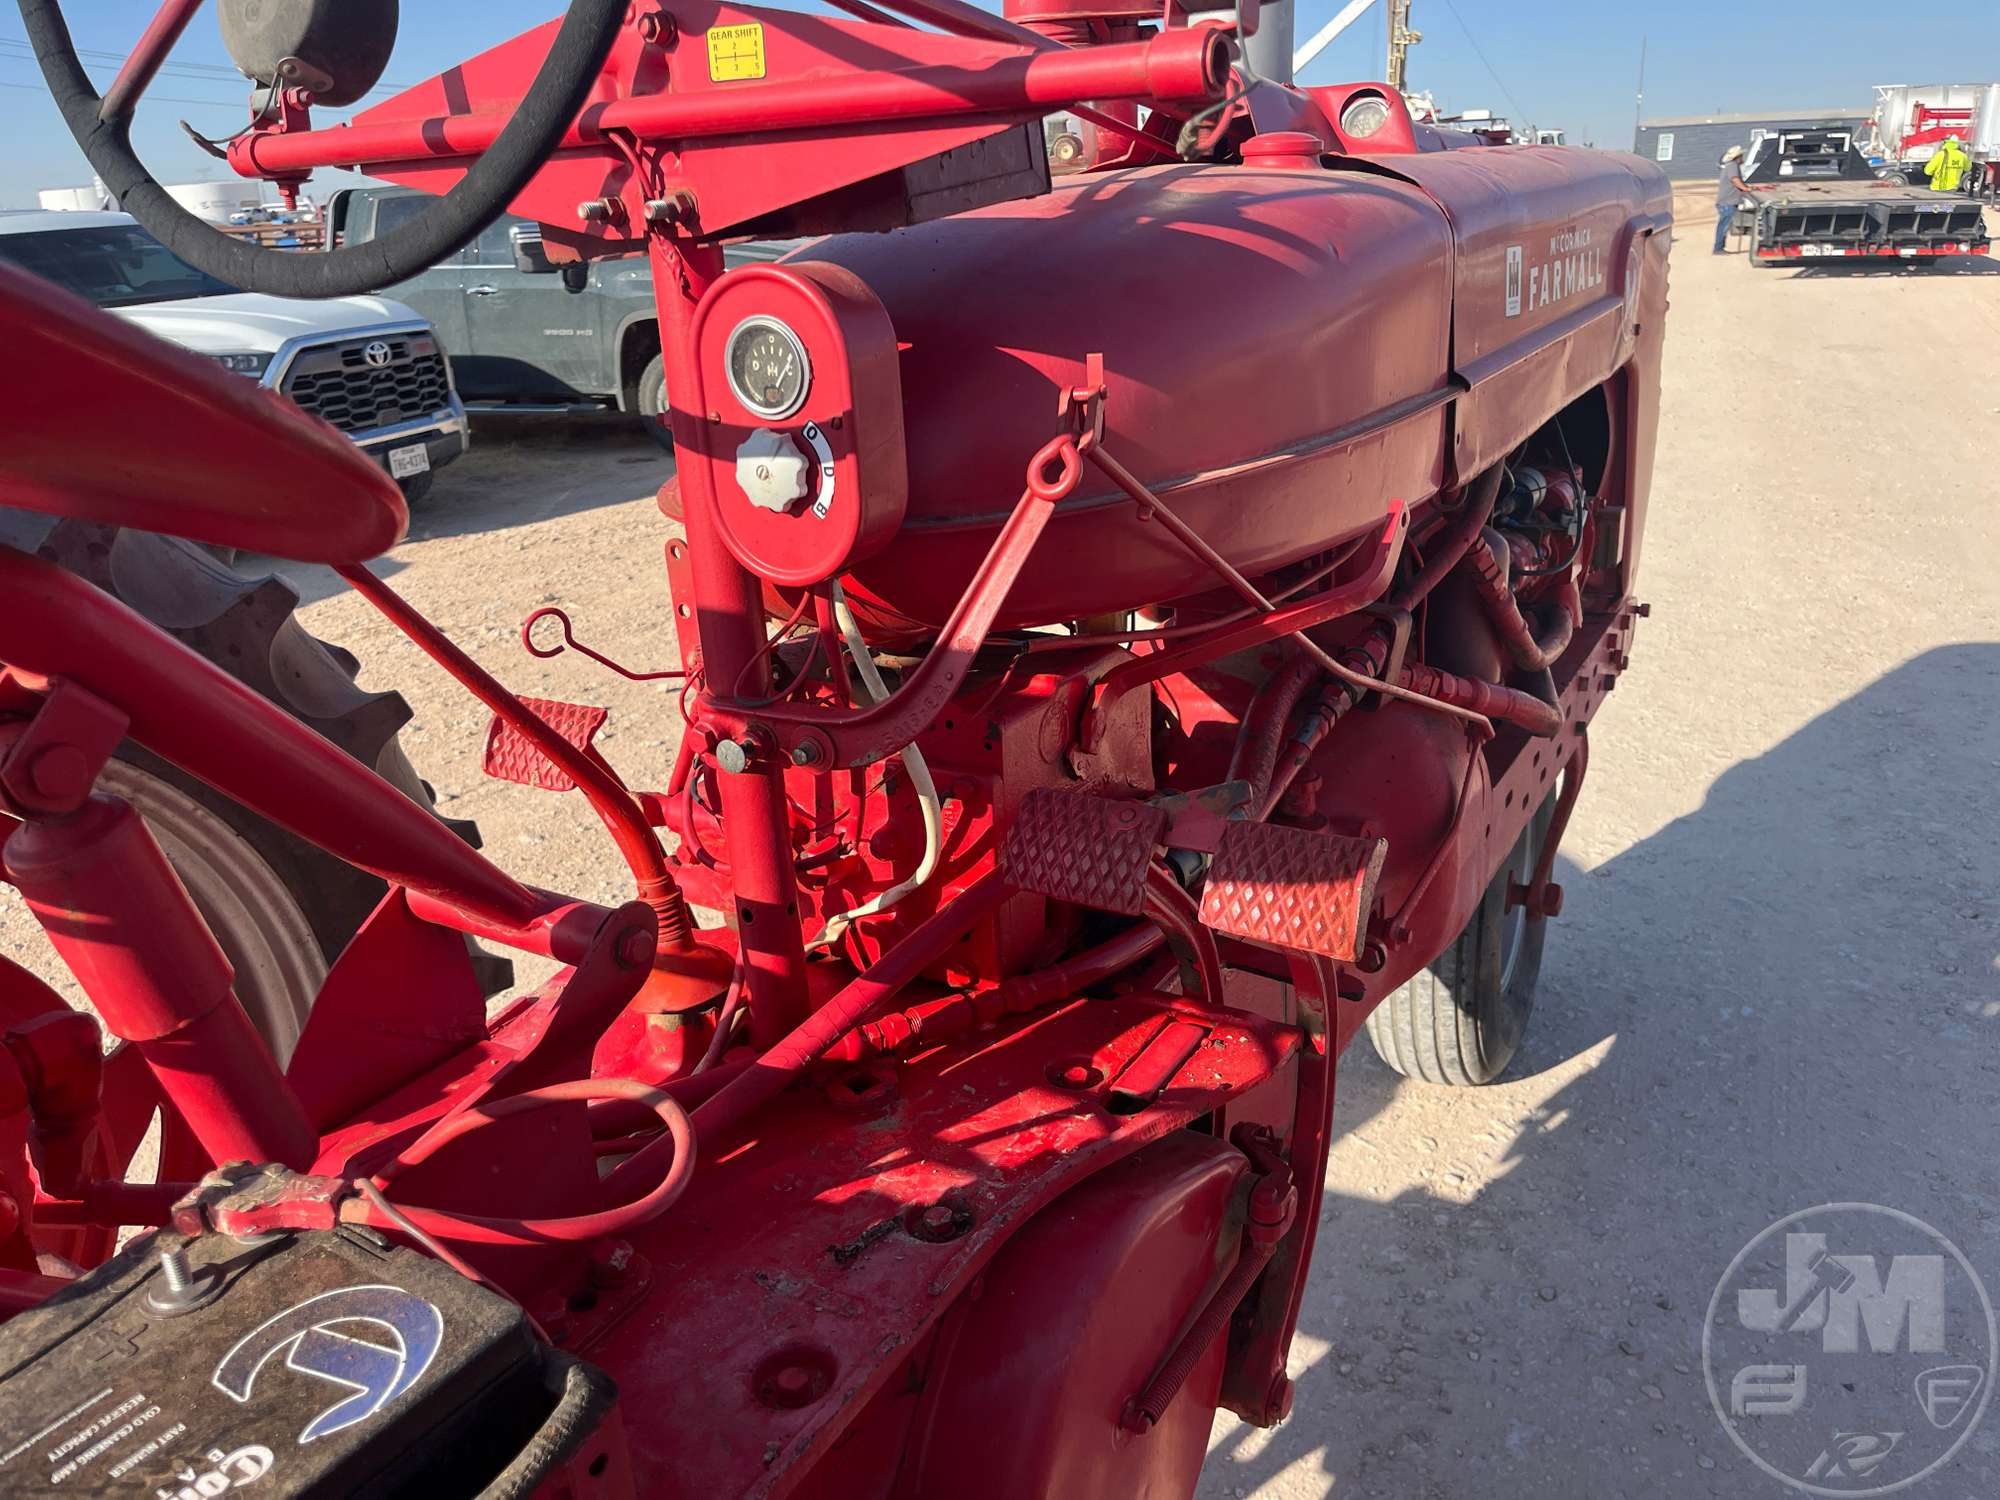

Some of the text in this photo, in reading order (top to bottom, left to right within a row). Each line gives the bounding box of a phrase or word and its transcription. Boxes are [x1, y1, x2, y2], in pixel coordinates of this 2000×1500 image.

[710, 27, 758, 41] GEAR SHIFT
[732, 41, 737, 50] 2
[1529, 248, 1602, 311] FARMALL
[824, 466, 835, 477] D
[816, 502, 828, 515] B
[98, 1393, 146, 1427] RESERVE
[48, 1423, 100, 1463] CAPACITY
[51, 1405, 161, 1484] COLD CRANKING AMP
[108, 1422, 187, 1478] PART NUMBER
